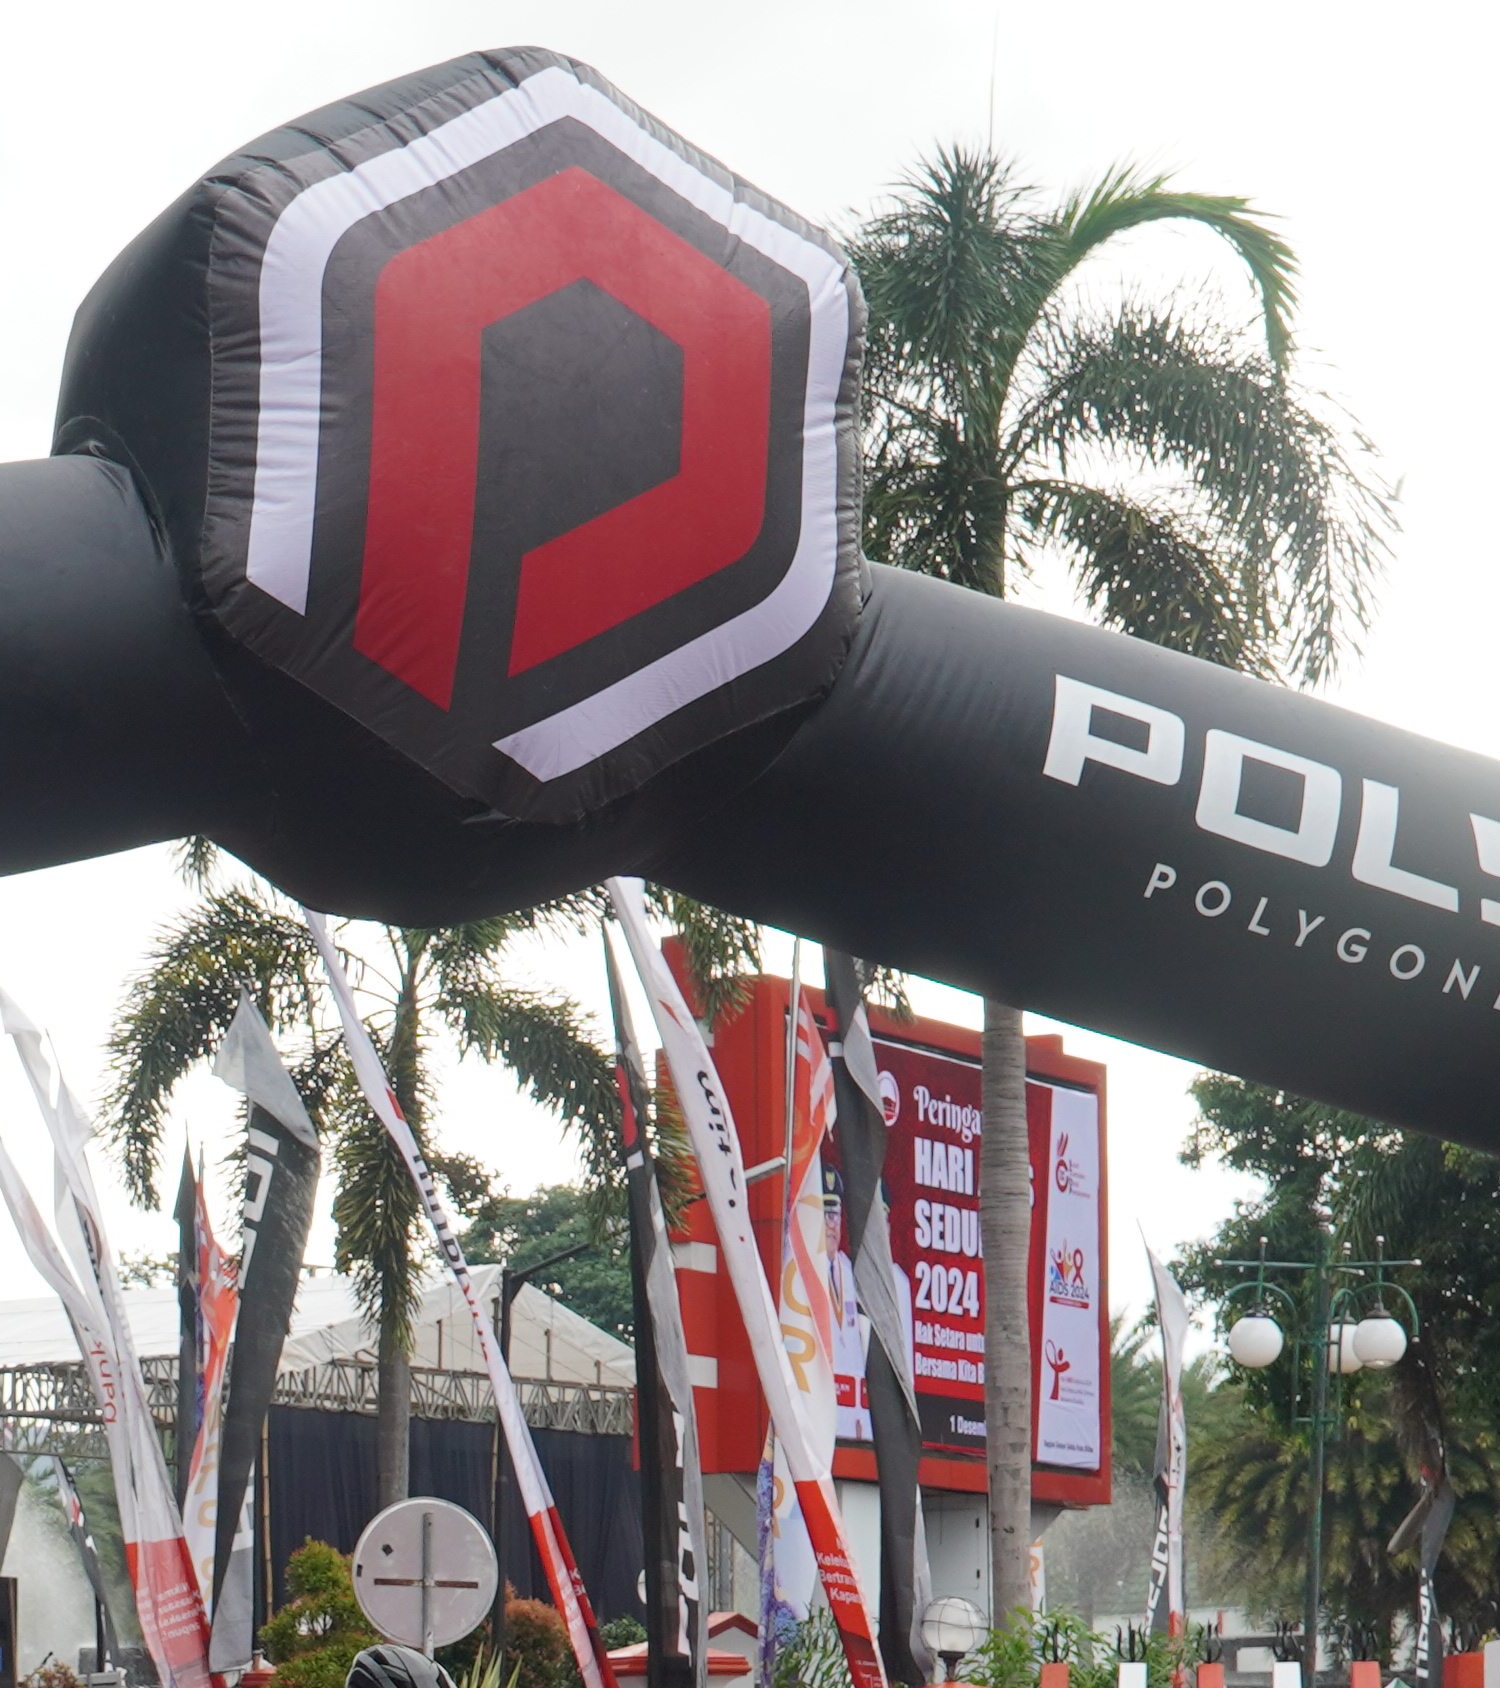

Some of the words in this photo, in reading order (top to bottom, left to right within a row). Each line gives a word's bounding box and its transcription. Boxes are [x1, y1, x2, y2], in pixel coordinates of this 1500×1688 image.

[913, 1085, 982, 1143] Peringa
[914, 1136, 974, 1196] HARI
[914, 1198, 983, 1258] SEDU
[914, 1262, 980, 1318] 2024
[957, 1415, 987, 1436] Desem
